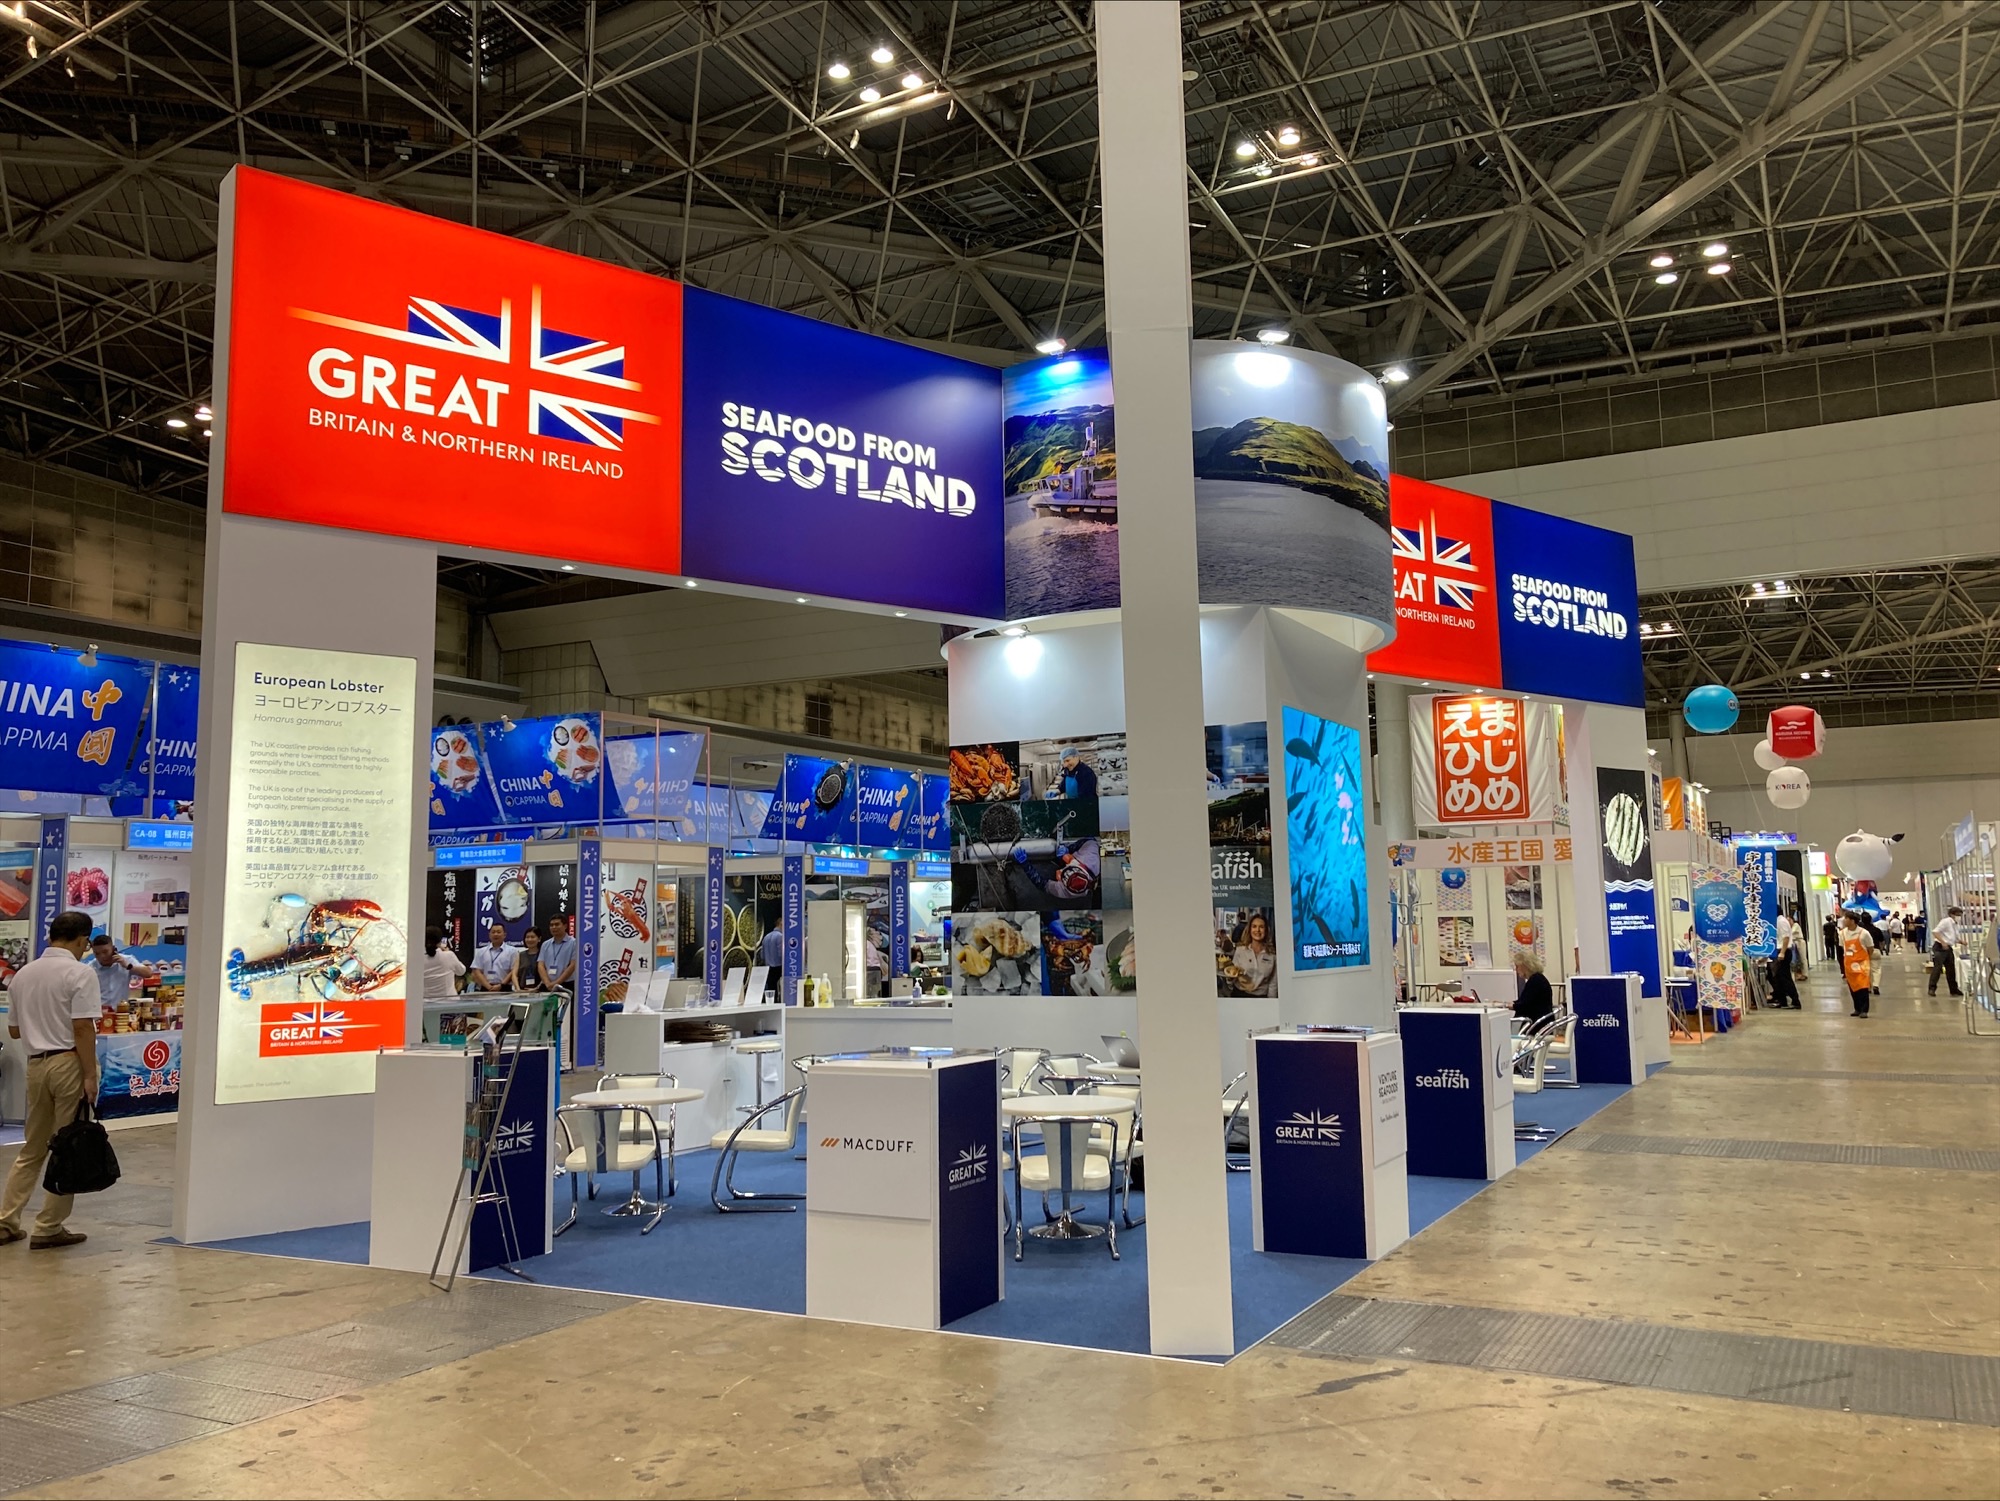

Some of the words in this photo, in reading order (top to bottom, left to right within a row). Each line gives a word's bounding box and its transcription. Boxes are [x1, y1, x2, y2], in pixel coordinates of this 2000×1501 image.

[308, 347, 509, 428] GREAT
[309, 408, 394, 440] BRITAIN
[401, 425, 417, 443] &
[422, 429, 535, 464] NORTHERN
[542, 450, 624, 480] IRELAND
[721, 402, 856, 452] SEAFOOD
[863, 432, 936, 470] FROM
[721, 431, 976, 517] SCOTLAND
[1511, 573, 1572, 600] SEAFOOD
[1573, 586, 1608, 609] FROM
[1396, 607, 1439, 624] NORTHERN
[1441, 612, 1475, 630] IRELAND
[1512, 593, 1628, 640] SCOTLAND
[254, 672, 326, 690] European
[330, 678, 384, 694] Lobster
[255, 694, 402, 715] ヨーロピアンロブスター
[254, 714, 294, 724] Homarus
[296, 717, 343, 727] gammarus
[146, 738, 197, 759] CHIN
[250, 740, 264, 748] The
[264, 741, 276, 749] UK
[276, 742, 307, 751] coastline
[307, 744, 336, 752] provides
[350, 746, 372, 755] fishing
[250, 750, 278, 759] grounds
[279, 751, 300, 759] where
[301, 752, 338, 762] low-impact
[338, 754, 361, 763] fishing
[361, 755, 390, 763] methods
[1442, 703, 1482, 813] えひめ
[1479, 700, 1521, 811] まじめ
[249, 758, 283, 768] exemplify
[283, 759, 295, 767] the
[312, 761, 354, 770] commitment
[363, 763, 383, 772] highly
[249, 767, 288, 775] responsible
[289, 768, 321, 777] practices.
[248, 783, 261, 791] The
[262, 784, 274, 792] UK
[316, 787, 342, 796] leading
[342, 788, 375, 797] producers
[500, 777, 542, 793] CHINA
[247, 802, 264, 810] high
[264, 803, 290, 811] quality,
[290, 803, 321, 812] premium
[321, 804, 351, 812] produce.
[248, 793, 282, 802] European
[282, 794, 306, 802] lobster
[306, 795, 345, 805] specialising
[364, 798, 386, 806] supply
[514, 795, 548, 806] CAPPMA
[858, 786, 894, 807] CHINA
[859, 811, 889, 825] CAPPMA
[1447, 839, 1544, 864] 水産王国
[583, 874, 594, 932] CHINA
[710, 878, 719, 930] CHINA
[789, 883, 798, 930] CHINA
[896, 885, 904, 928] CHINA
[789, 950, 798, 996] CAPPMA
[583, 960, 593, 1016] CAPPMA
[1582, 1015, 1619, 1028] seafish
[270, 1027, 316, 1041] GREAT
[1415, 1070, 1470, 1089] seafish
[1275, 1126, 1315, 1139] GREAT
[843, 1137, 914, 1153] MACDUFF
[949, 1165, 973, 1184] GREAT
